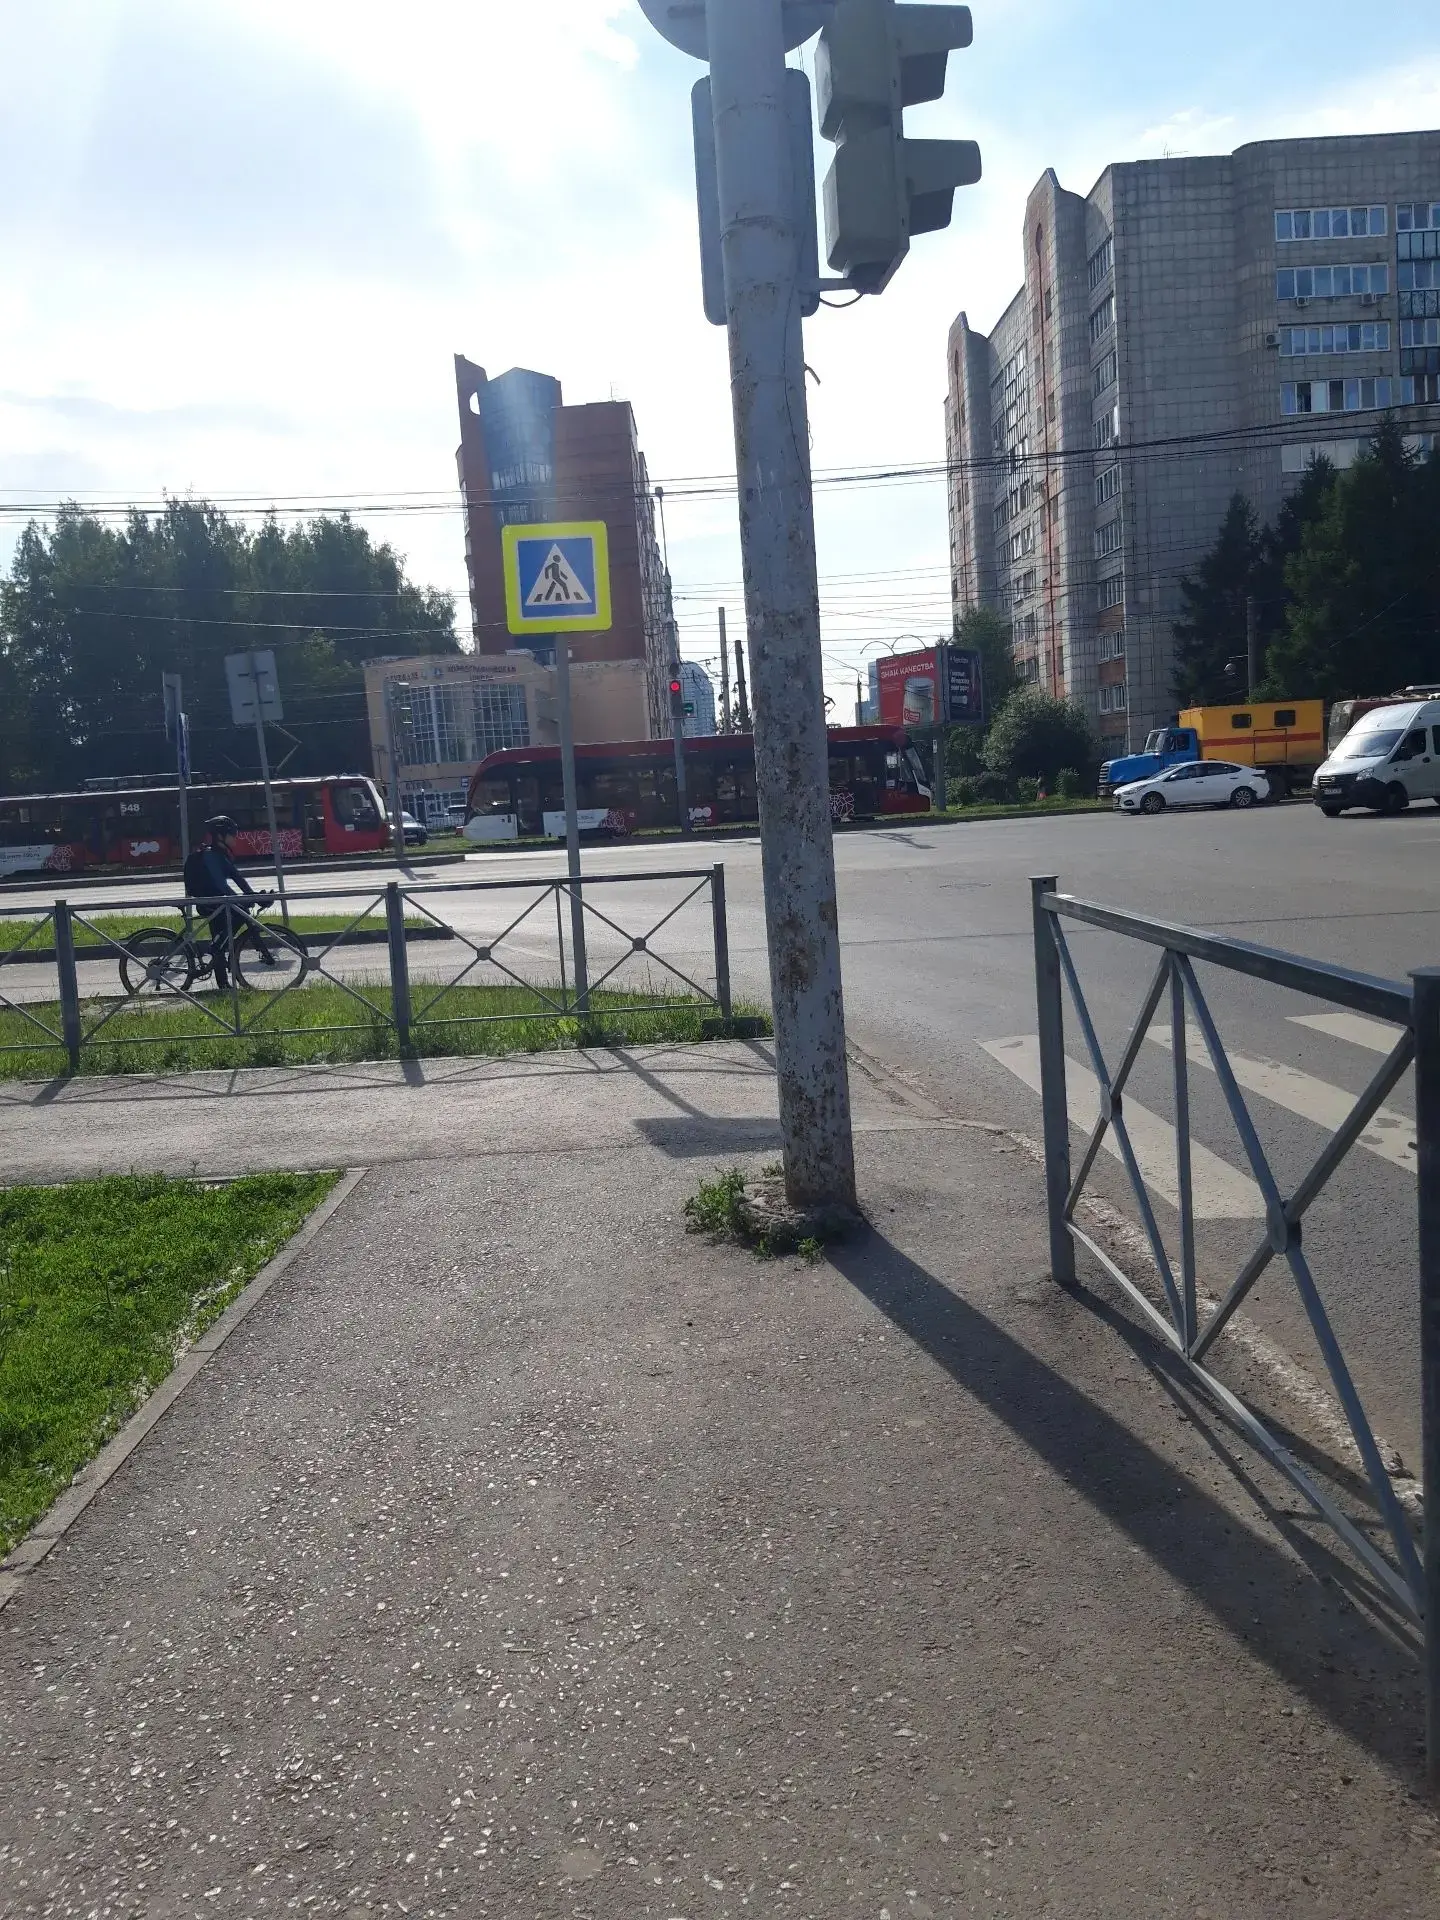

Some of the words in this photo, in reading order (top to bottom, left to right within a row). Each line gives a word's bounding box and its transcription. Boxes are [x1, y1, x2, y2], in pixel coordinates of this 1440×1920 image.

[880, 670, 900, 679] ЗНАК
[900, 662, 934, 675] КАЧЕСТВА
[121, 803, 140, 812] 548
